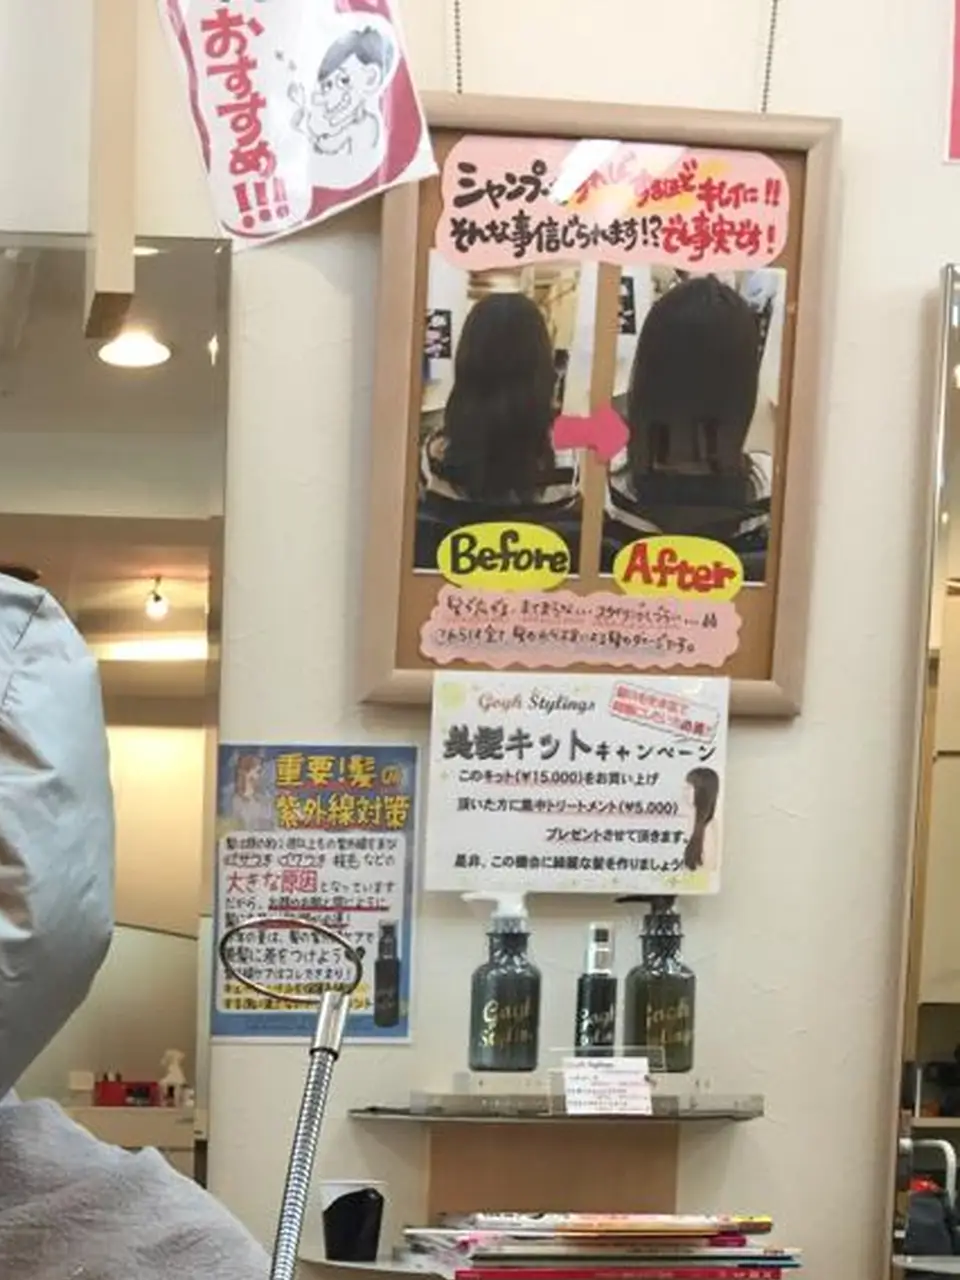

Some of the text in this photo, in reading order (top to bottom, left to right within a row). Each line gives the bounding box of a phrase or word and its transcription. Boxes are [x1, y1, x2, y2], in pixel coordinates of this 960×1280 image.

[450, 529, 569, 574] Before
[622, 542, 738, 593] After
[276, 794, 410, 829] 紫外線対策
